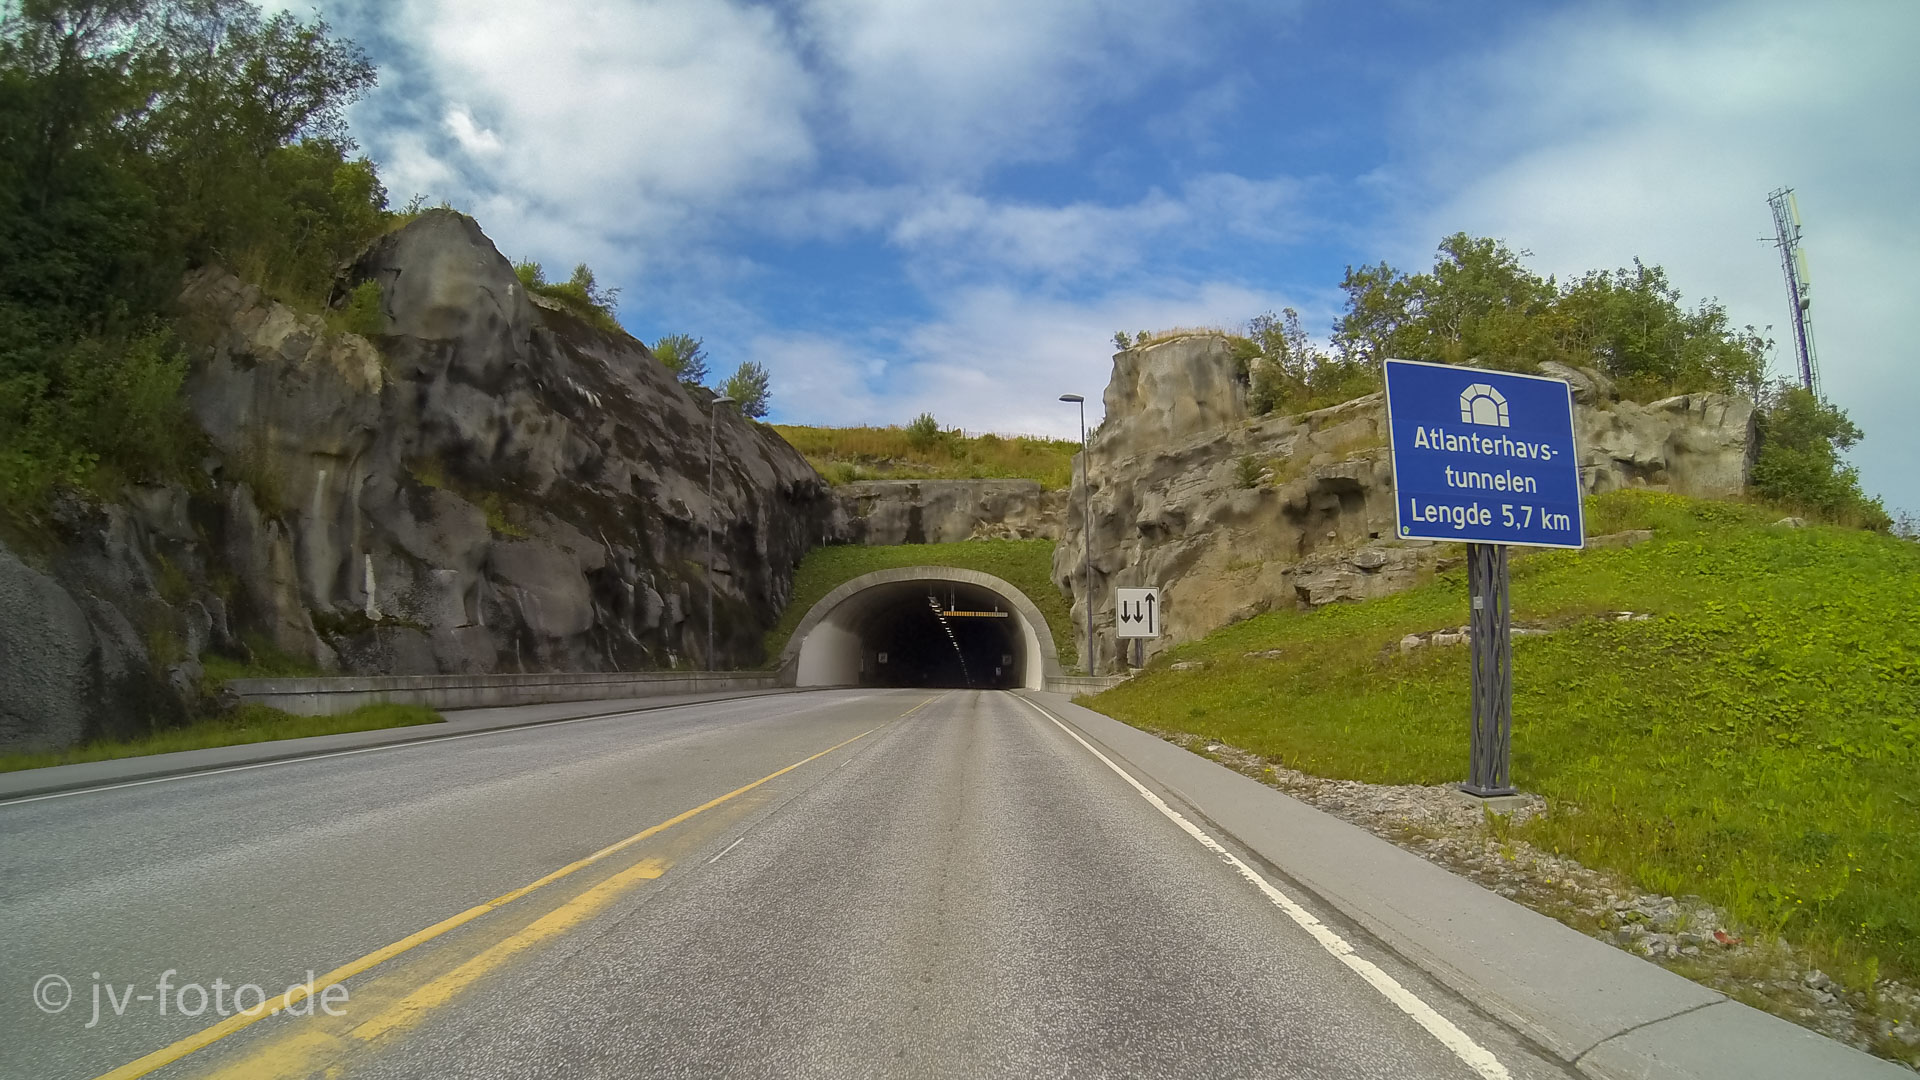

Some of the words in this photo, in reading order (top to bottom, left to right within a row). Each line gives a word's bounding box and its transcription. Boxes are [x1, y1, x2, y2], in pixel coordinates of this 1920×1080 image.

[1414, 426, 1558, 460] Atlanterhavs-
[1445, 465, 1537, 493] tunnelen
[1411, 498, 1492, 530] Lengde
[1501, 504, 1533, 530] 5,7
[1541, 507, 1570, 531] km
